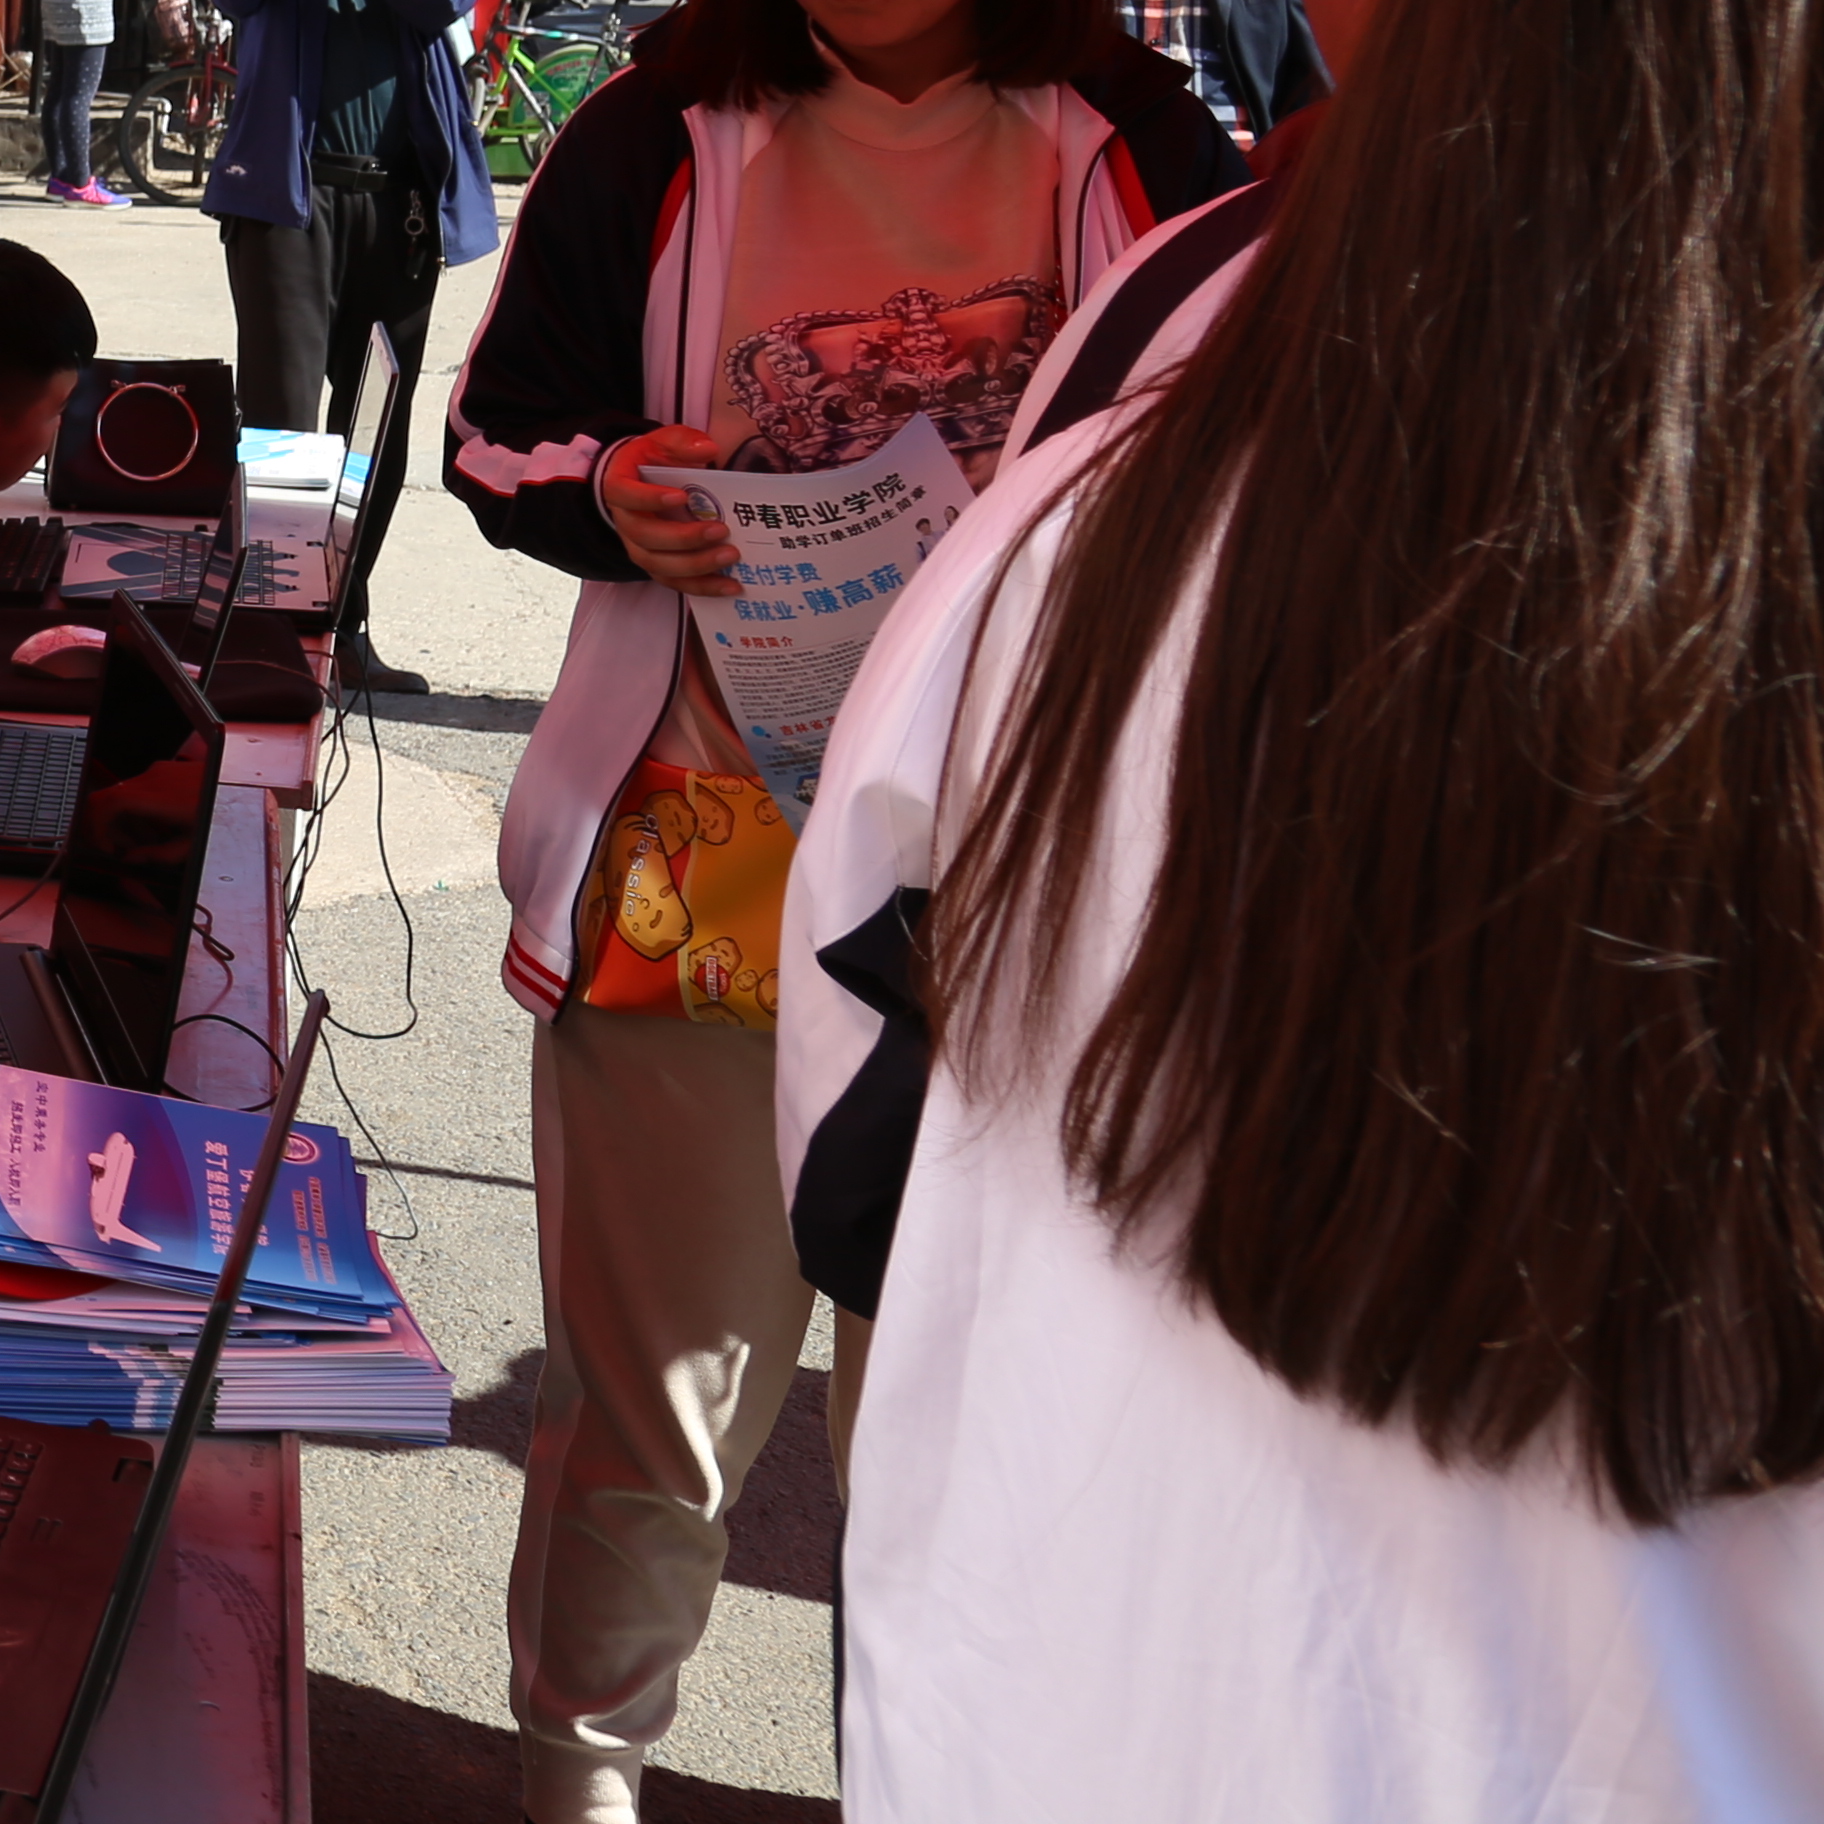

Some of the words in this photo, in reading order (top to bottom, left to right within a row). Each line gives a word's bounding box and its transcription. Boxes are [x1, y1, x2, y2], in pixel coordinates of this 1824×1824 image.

[732, 472, 907, 531] 伊春职业学院
[739, 635, 794, 649] 学院简介
